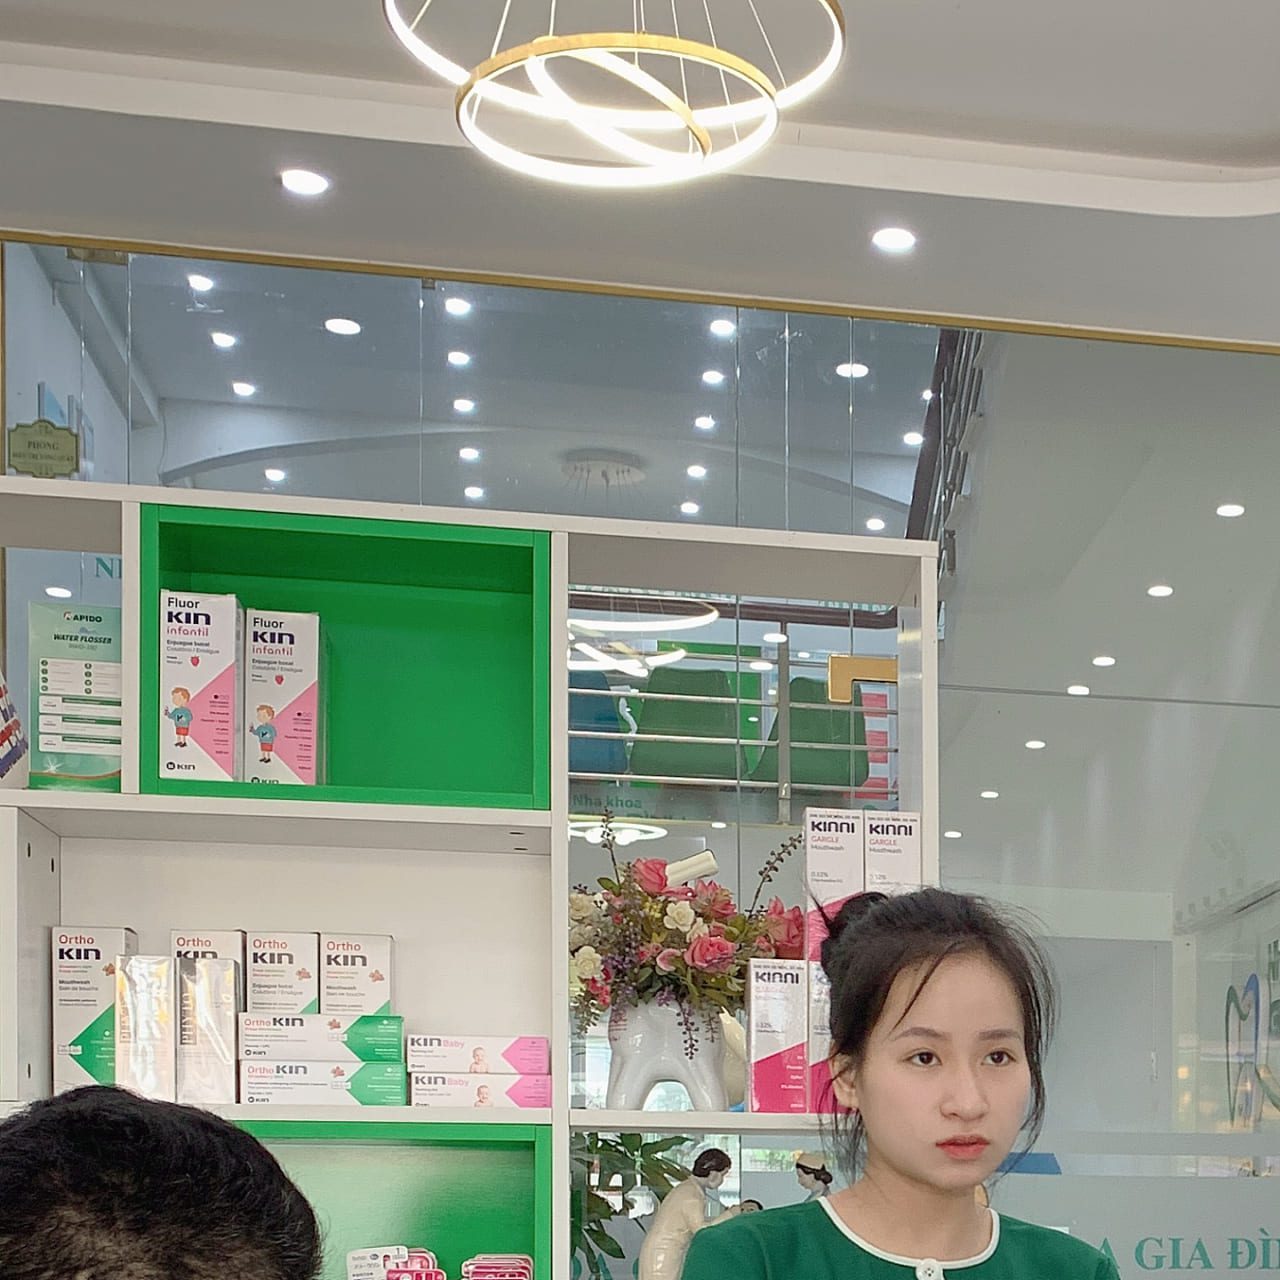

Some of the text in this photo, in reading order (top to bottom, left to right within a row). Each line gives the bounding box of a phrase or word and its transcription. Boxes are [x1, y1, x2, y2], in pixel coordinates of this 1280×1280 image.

[167, 597, 200, 608] Fluor
[253, 617, 285, 628] Fluor
[167, 626, 208, 637] infantil
[54, 633, 112, 644] WATER FLOSSER
[252, 645, 293, 656] infantil
[607, 796, 642, 808] khoa
[59, 934, 94, 944] Ortho
[176, 937, 212, 947] Ortho
[253, 939, 288, 949] Ortho
[326, 941, 361, 951] Ortho
[244, 1018, 271, 1027] Ortho
[443, 1039, 465, 1048] Baby
[248, 1066, 274, 1074] Ortho
[447, 1078, 469, 1087] Baby
[1134, 1237, 1214, 1270] GIA
